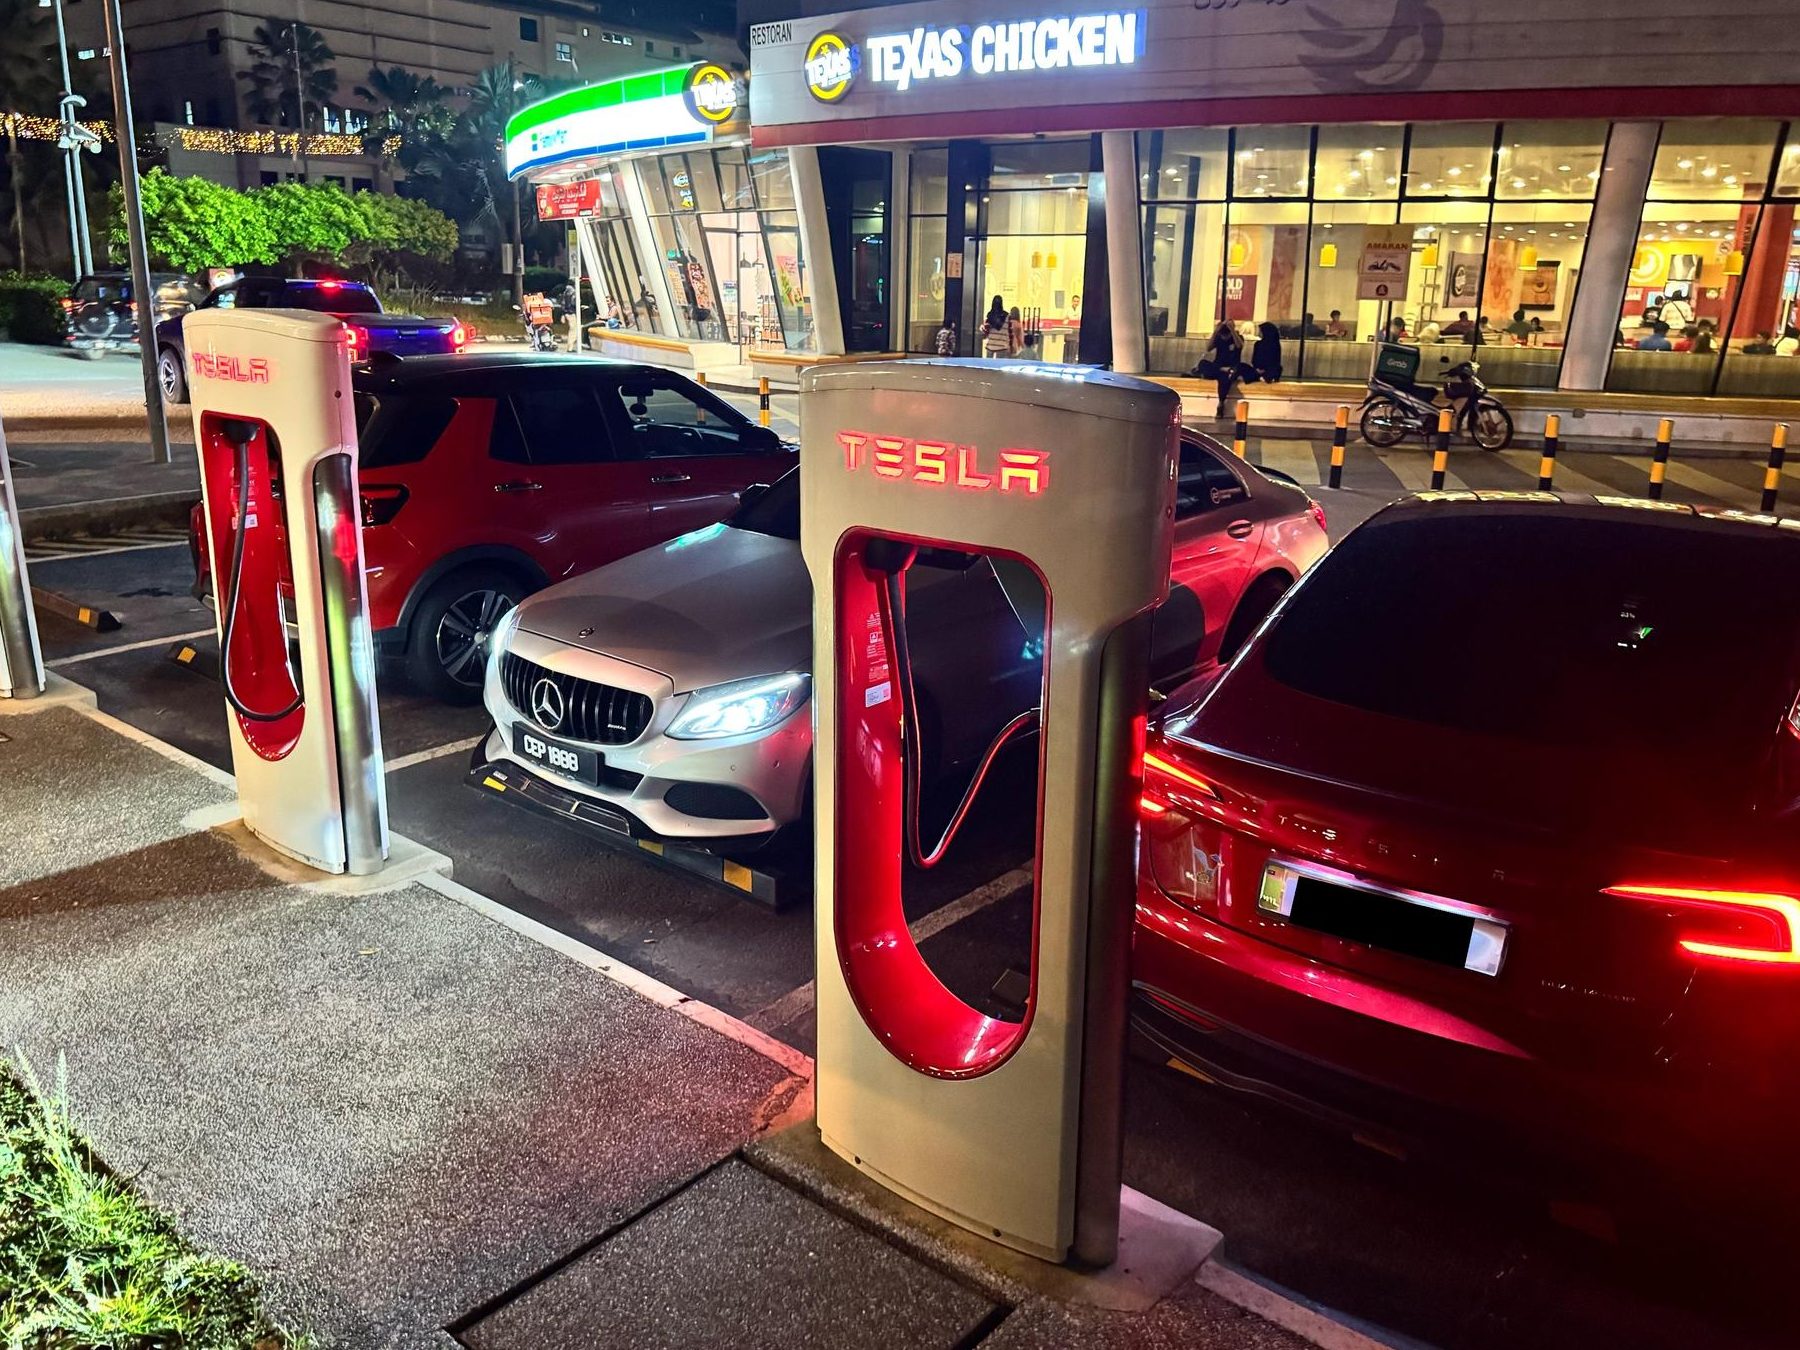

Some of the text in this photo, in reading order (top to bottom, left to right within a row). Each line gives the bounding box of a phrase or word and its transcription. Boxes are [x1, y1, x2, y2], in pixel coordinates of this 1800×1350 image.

[751, 24, 792, 46] RESTORAN
[867, 12, 1138, 90] TEXAS CHICKEN
[1366, 242, 1408, 250] AMARAN
[193, 353, 269, 384] TESLA
[836, 431, 1045, 494] TESLA
[524, 734, 546, 758] CEP
[547, 745, 579, 772] 1888
